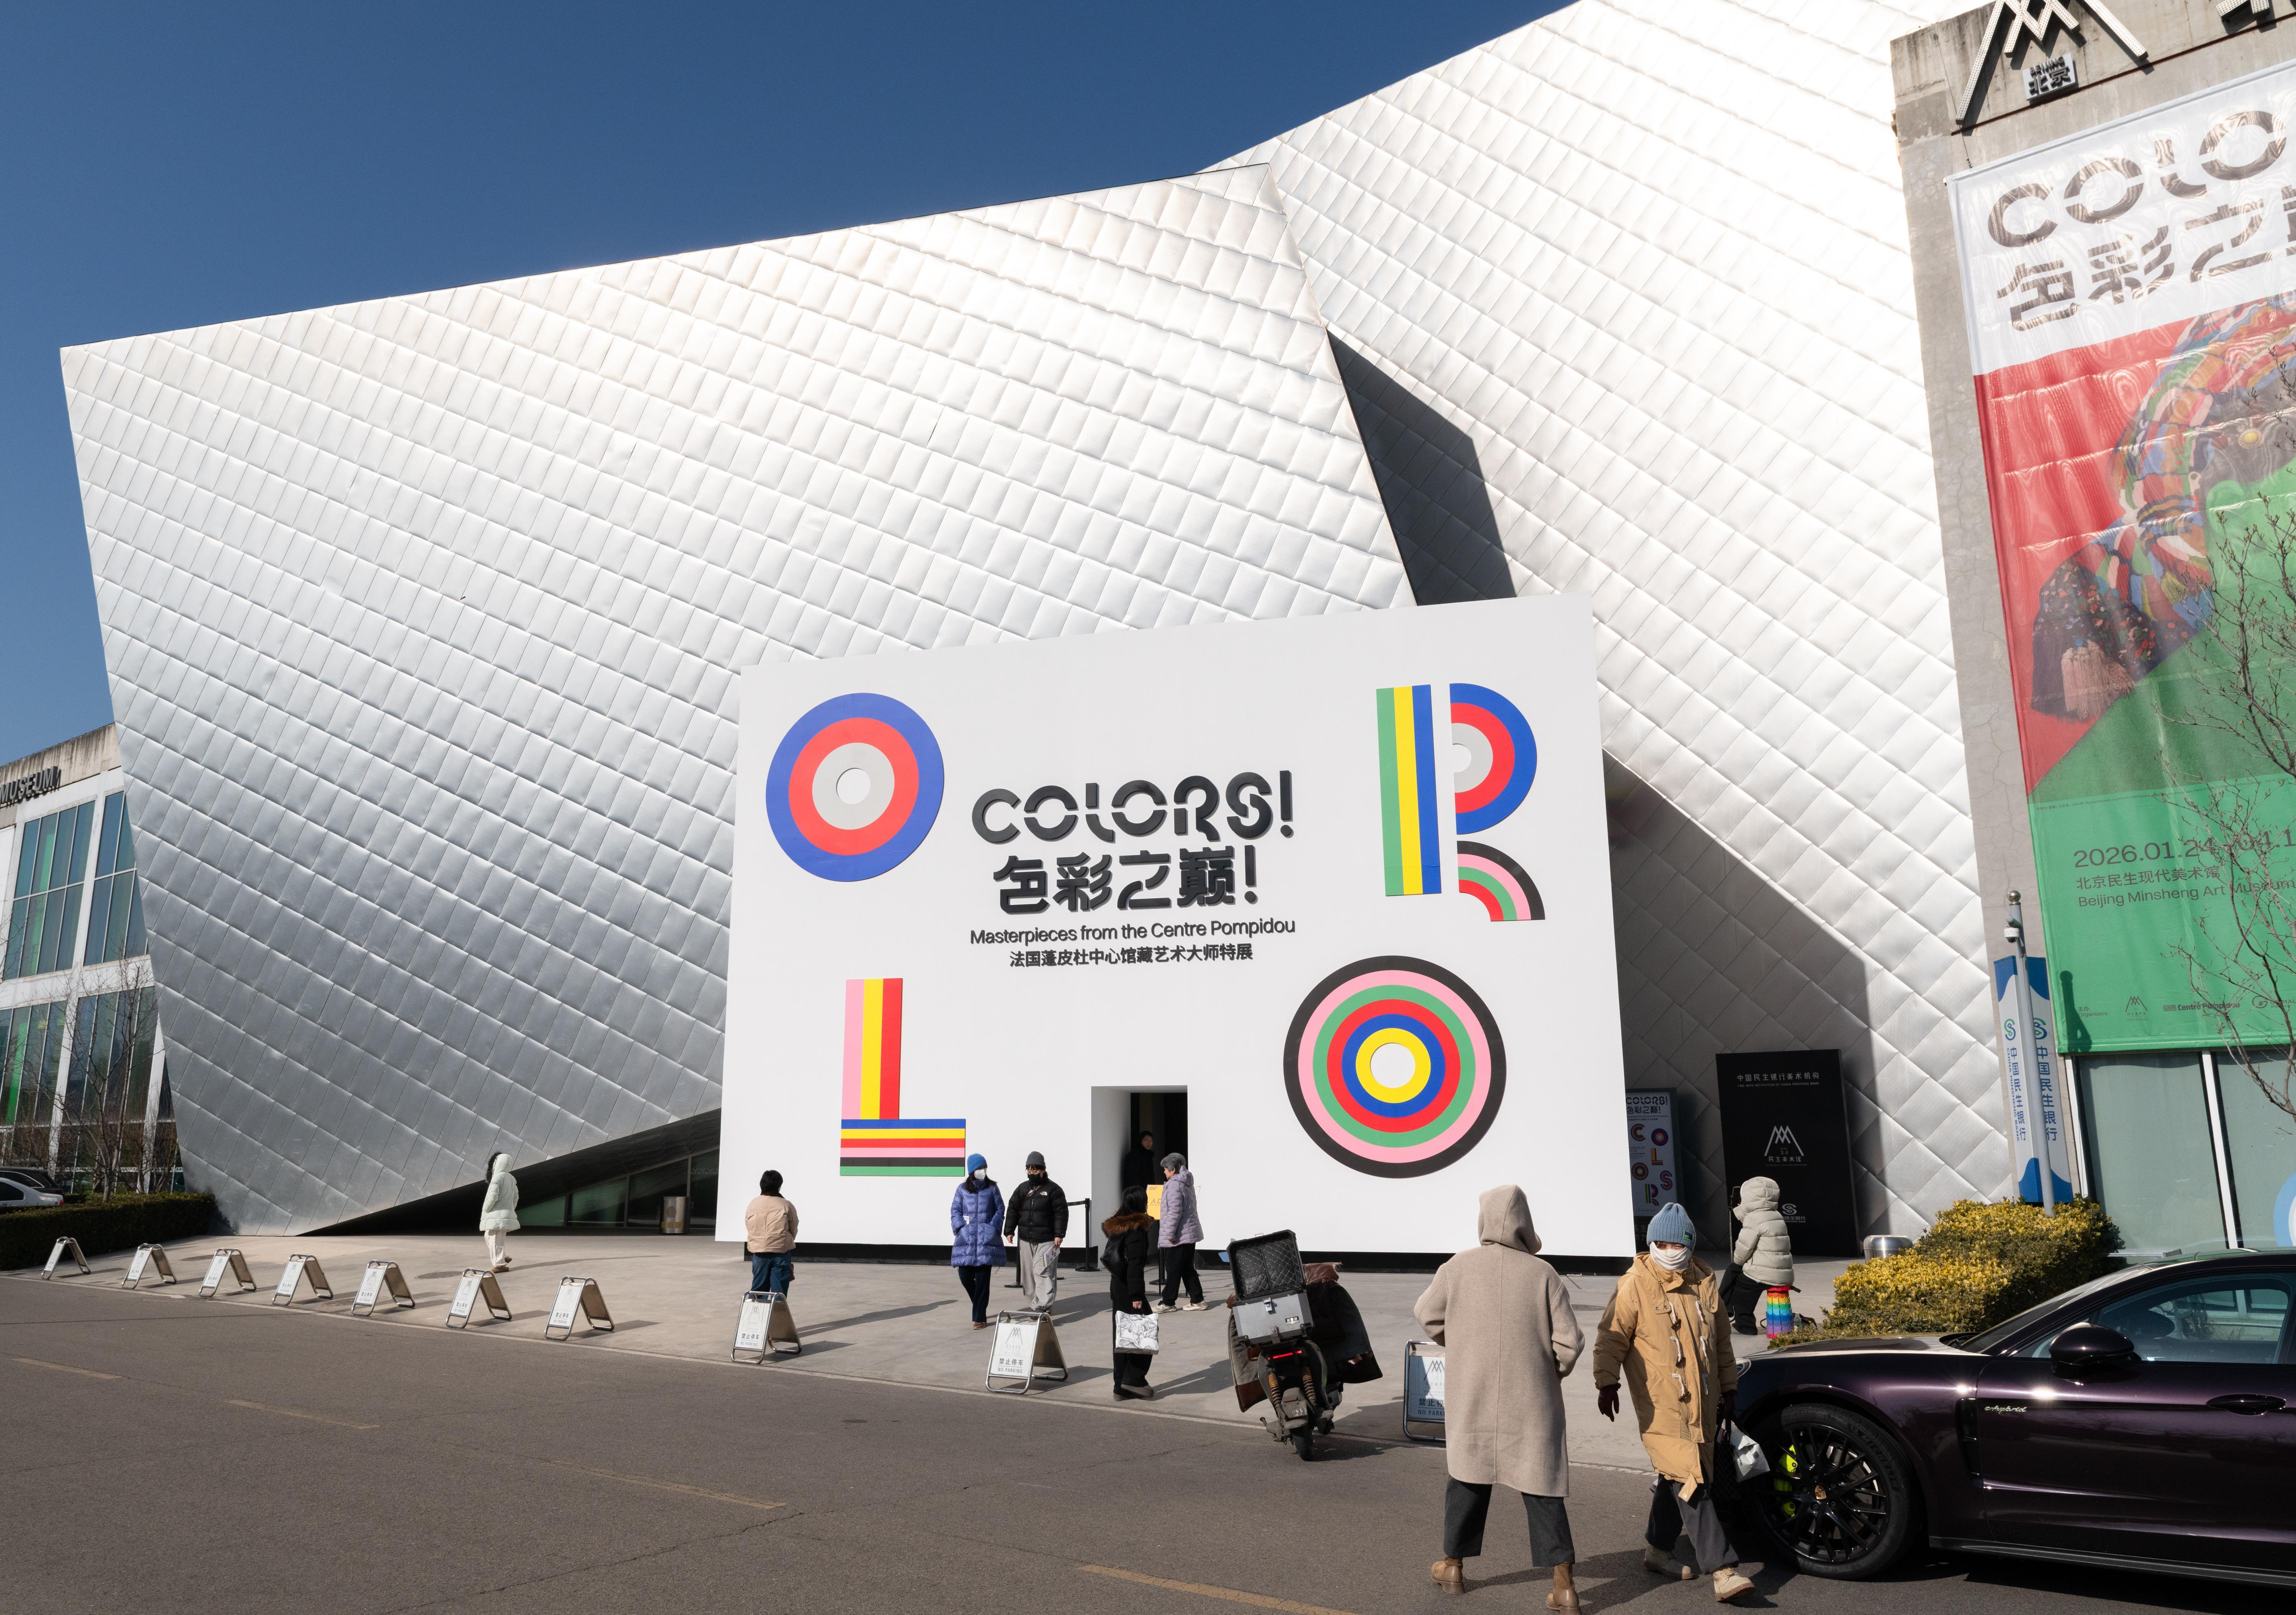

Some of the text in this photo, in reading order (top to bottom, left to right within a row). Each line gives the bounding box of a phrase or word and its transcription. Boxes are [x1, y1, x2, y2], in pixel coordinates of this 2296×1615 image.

[2030, 56, 2065, 77] BEIJING
[2028, 66, 2072, 95] 北京
[0, 766, 58, 804] MUSEUM
[972, 770, 1294, 844] COLORS!
[993, 845, 1258, 915] 色彩之巅!
[2076, 865, 2220, 890] 北京民生现代美术馆
[2078, 894, 2124, 908] Beijing
[2128, 888, 2199, 902] Minsheng
[2203, 885, 2226, 897] Art
[970, 918, 1296, 947] Masterpieces from the Centre Pompidou
[1009, 943, 1254, 968] 法国蓬皮杜中心馆藏艺术大师特展
[1737, 1072, 1819, 1082] 中国民生银行美术机构
[1626, 1096, 1668, 1105] COLORS!
[2011, 1047, 2026, 1141] 中国民生银行
[2037, 1046, 2057, 1141] 中国民生银行
[999, 1358, 1023, 1366] 禁止停车
[1419, 1398, 1445, 1407] 禁止停
